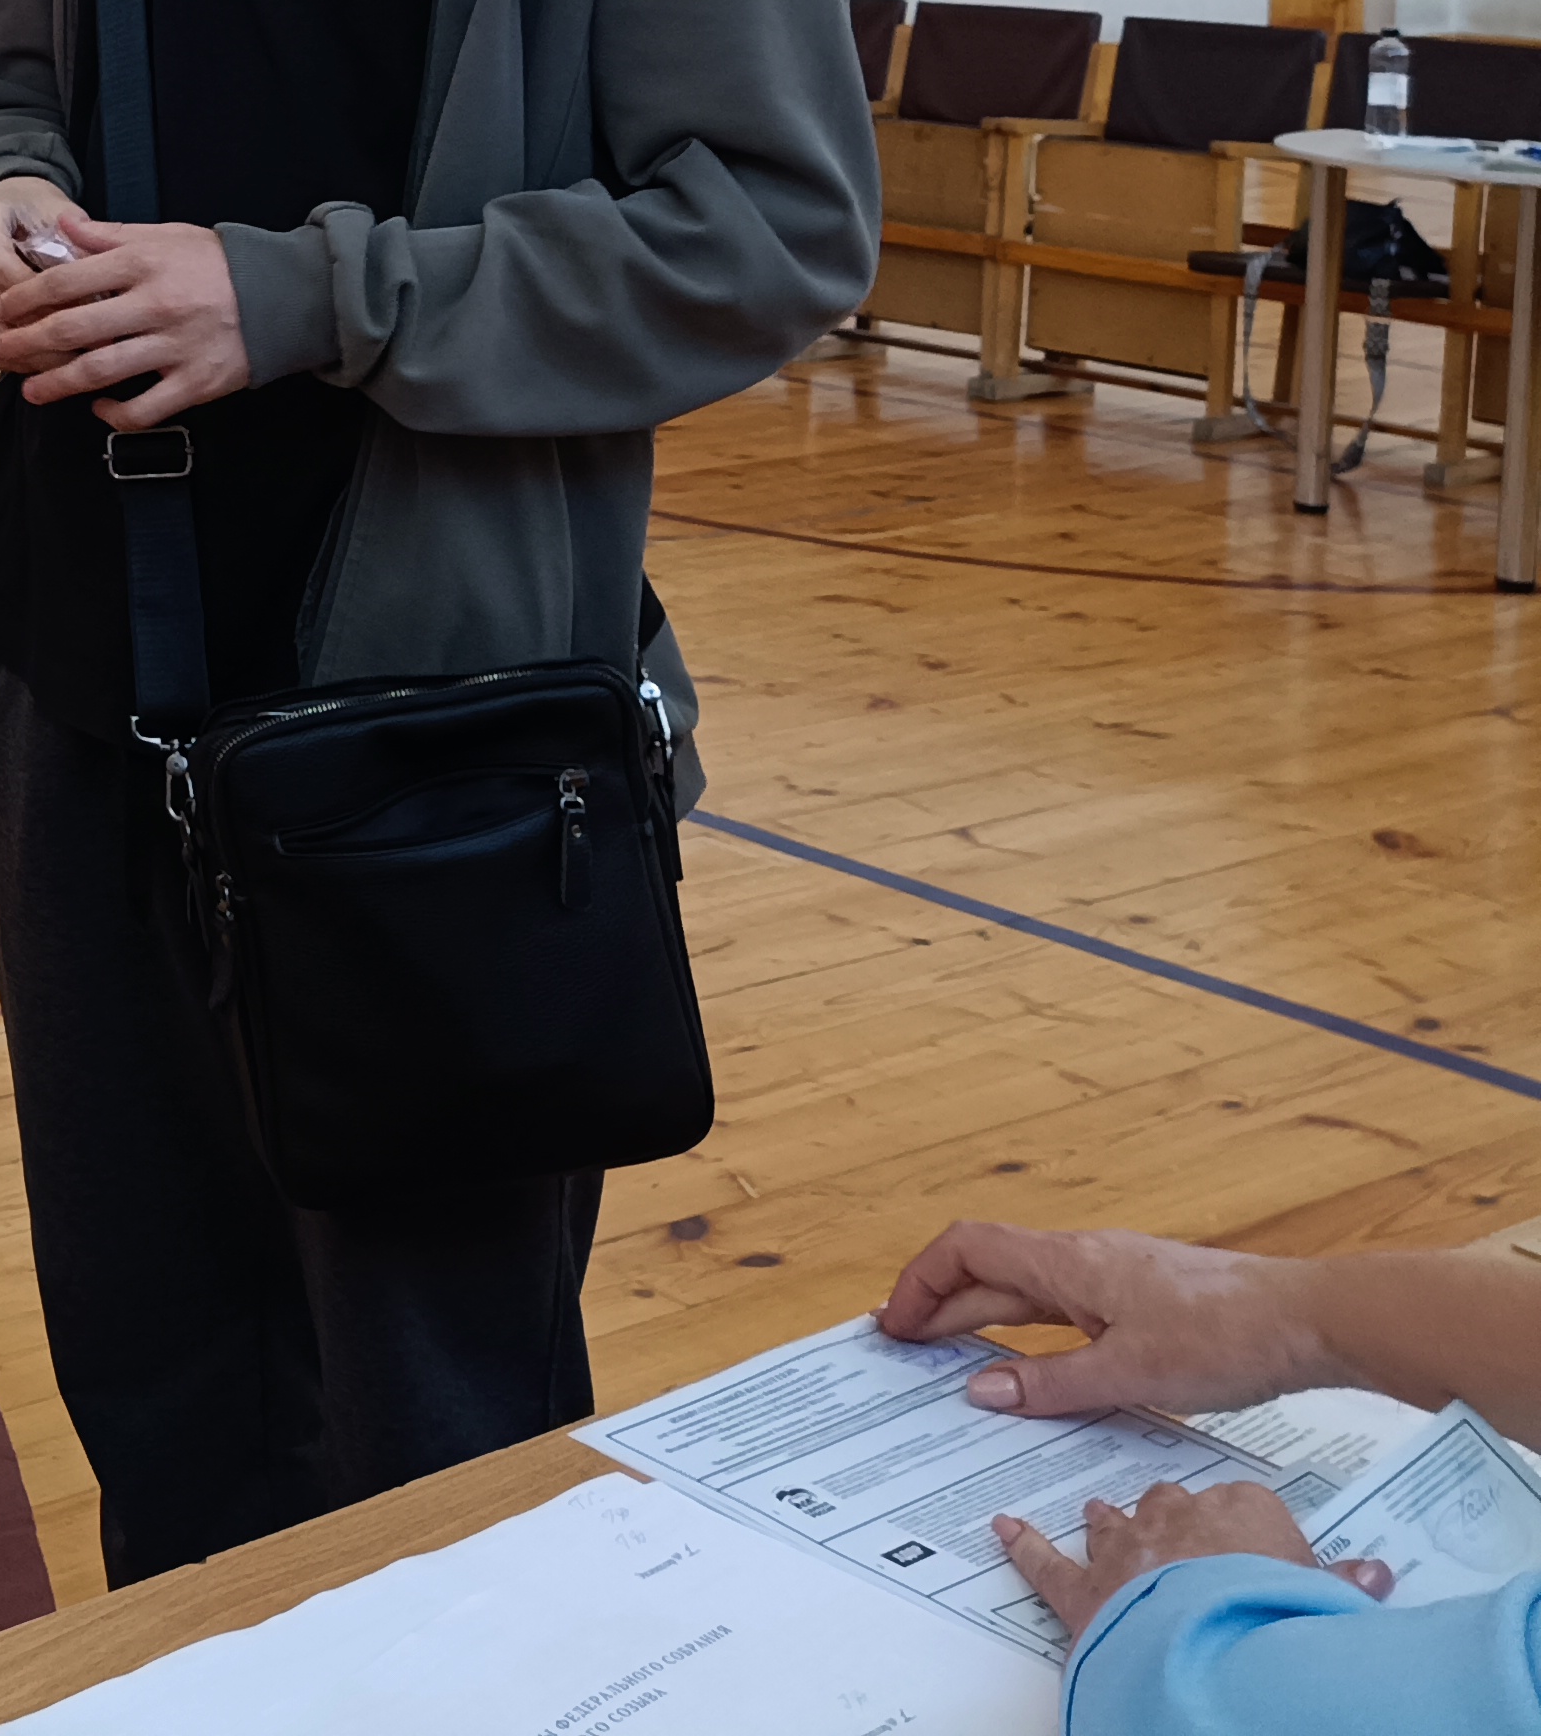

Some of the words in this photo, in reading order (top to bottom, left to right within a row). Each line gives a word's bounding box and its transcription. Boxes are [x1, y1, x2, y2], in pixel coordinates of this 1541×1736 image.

[555, 1662, 666, 1730] ФЕДЕРАЛЬНОГО
[661, 1624, 734, 1665] СОБРАНИЯ
[607, 1688, 668, 1723] СОЗЫВА
